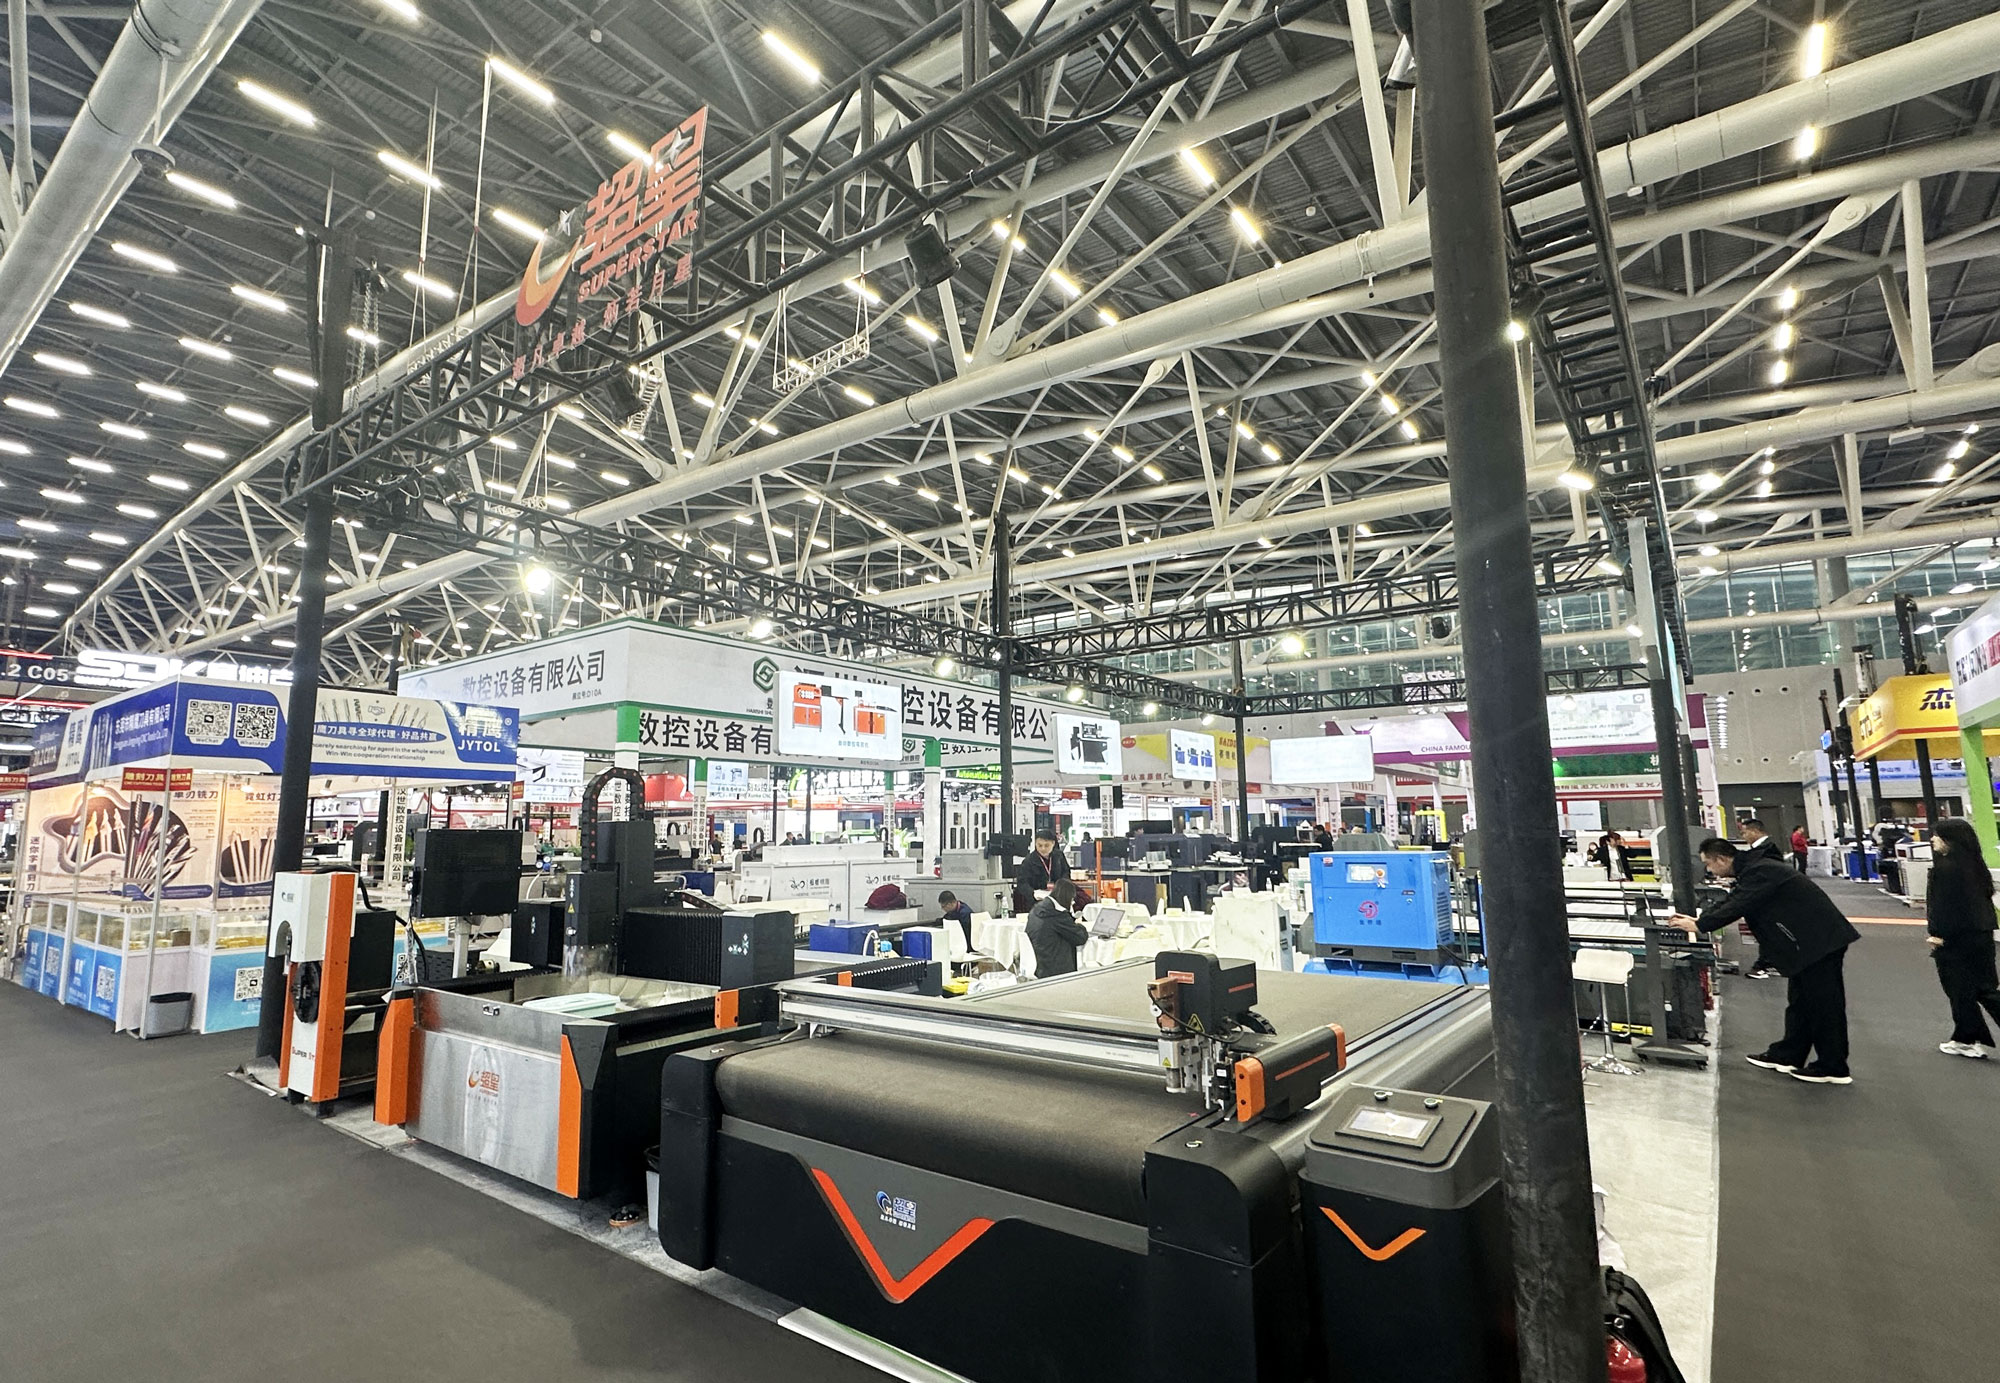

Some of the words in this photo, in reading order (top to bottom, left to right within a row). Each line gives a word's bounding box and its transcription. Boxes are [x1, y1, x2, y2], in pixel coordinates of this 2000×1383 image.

[577, 209, 699, 303] SUPERSTAR
[28, 665, 69, 682] C05
[336, 744, 366, 753] searching
[458, 739, 501, 752] JYTOL
